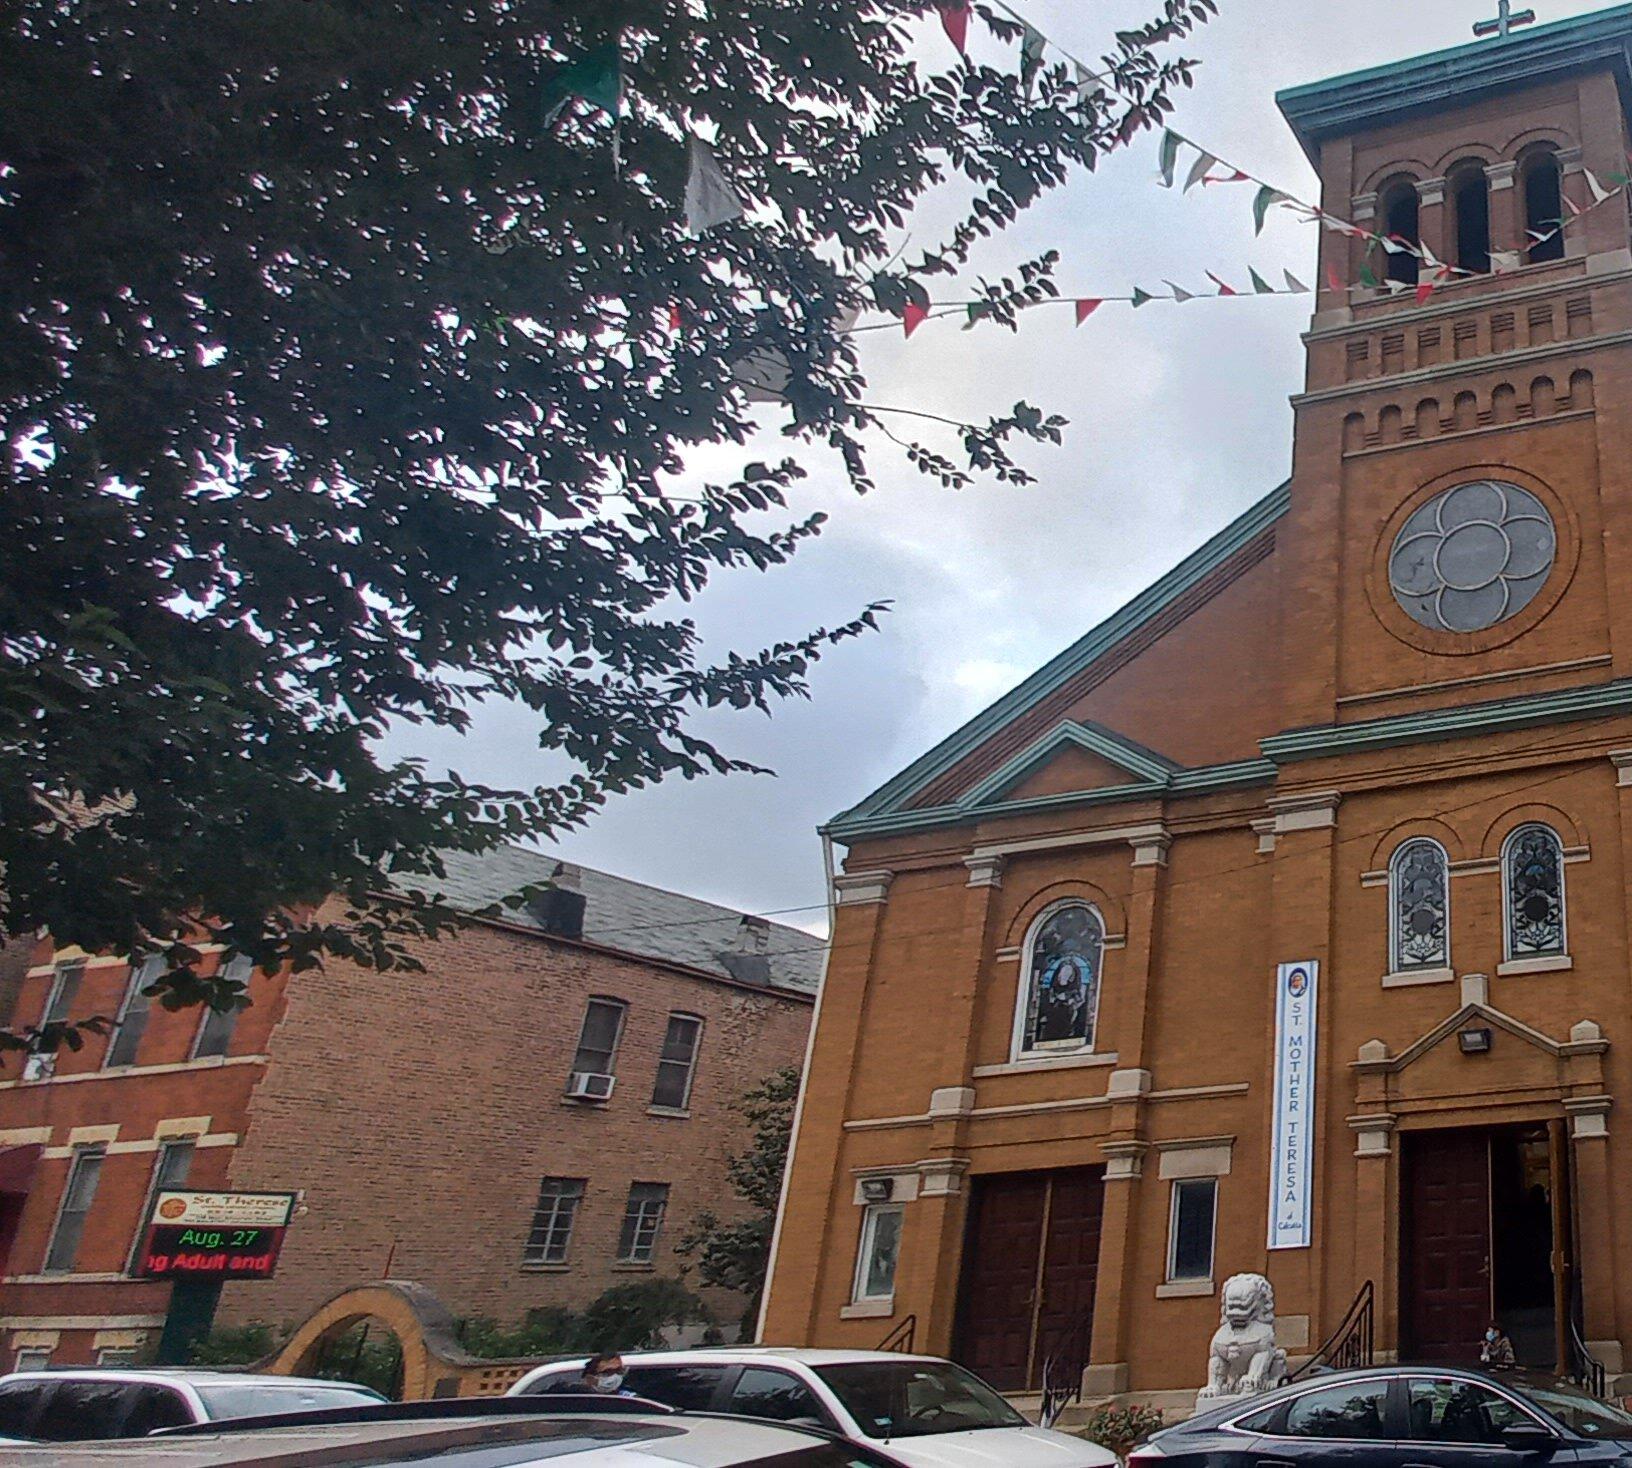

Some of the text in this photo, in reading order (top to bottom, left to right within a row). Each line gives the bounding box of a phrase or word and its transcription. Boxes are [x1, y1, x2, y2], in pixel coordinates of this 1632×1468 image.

[1285, 1002, 1303, 1202] ST. MOTHER TERESA
[222, 1196, 288, 1207] Therese
[179, 1229, 259, 1248] Aug. 27
[172, 1253, 228, 1270] Adult
[230, 1253, 270, 1271] and
